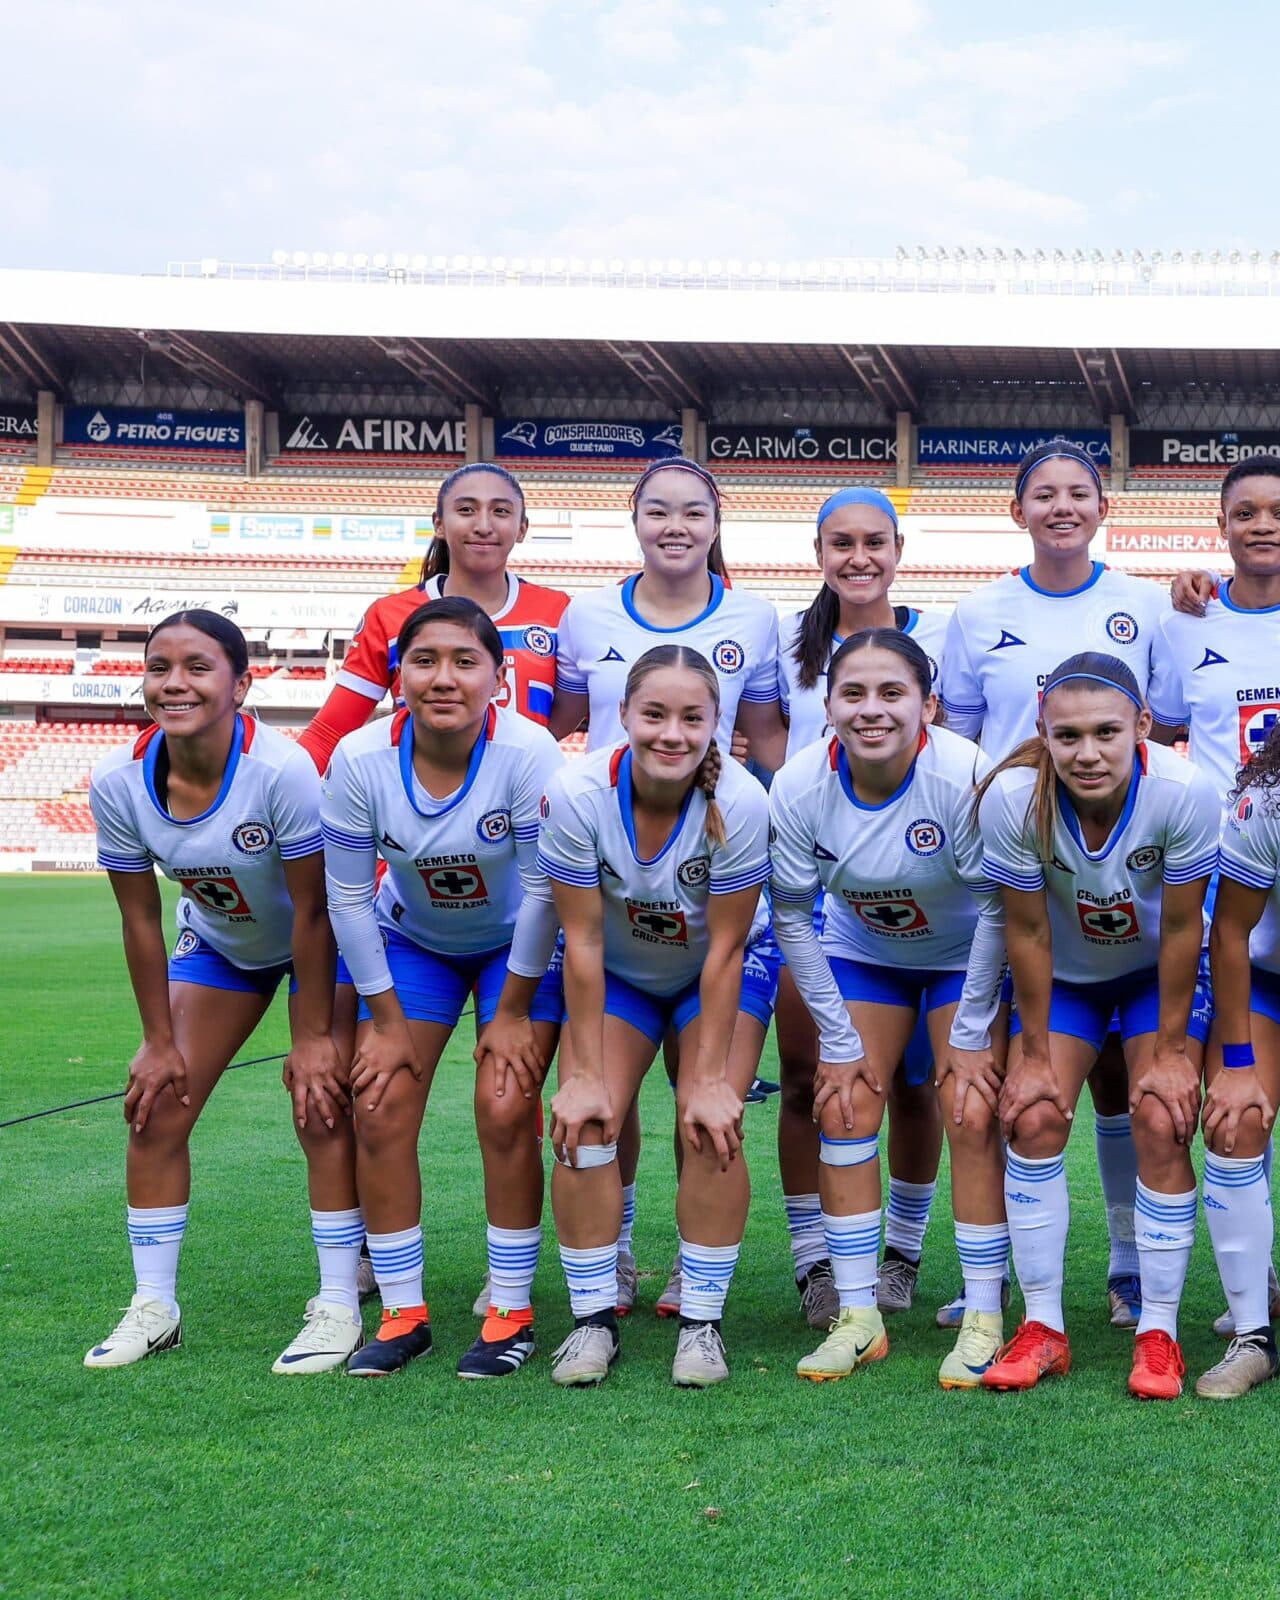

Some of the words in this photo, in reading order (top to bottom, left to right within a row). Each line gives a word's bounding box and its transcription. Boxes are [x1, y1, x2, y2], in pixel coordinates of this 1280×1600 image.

[117, 424, 171, 440] PETRO
[174, 426, 240, 443] FIGUE'S
[545, 422, 645, 447] CONSPIRADORES
[710, 435, 819, 459] GARMO
[920, 438, 1012, 455] HARINERA
[1111, 534, 1207, 550] HARINERA
[415, 853, 476, 868] CEMENTO
[172, 866, 231, 877] CEMENTO
[842, 888, 912, 900] CEMENTO
[1077, 888, 1131, 906] CEMENTO
[431, 900, 460, 909] CRUZ
[462, 898, 493, 909] AZUL
[625, 897, 681, 911] CEMENTO
[632, 928, 660, 943] CRUZ
[866, 926, 897, 938] CRUZ
[901, 927, 934, 938] AZUL
[1084, 935, 1113, 946] CRUZ
